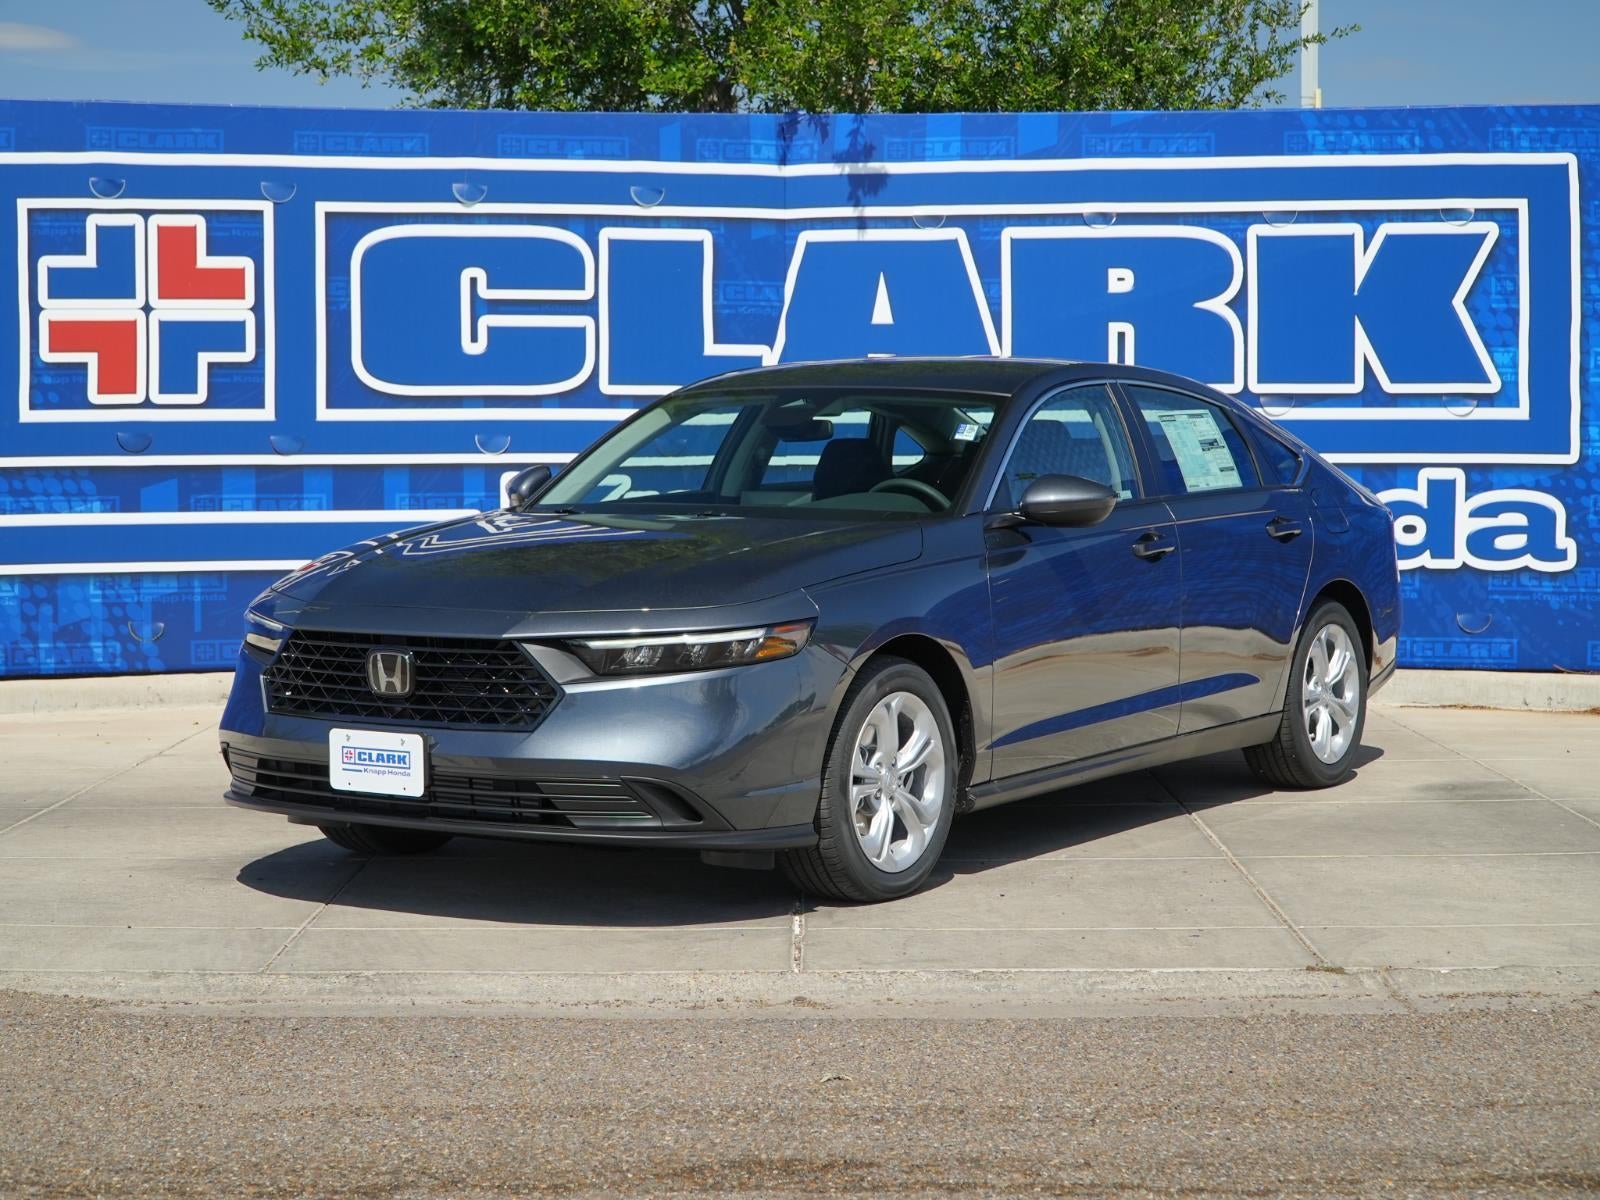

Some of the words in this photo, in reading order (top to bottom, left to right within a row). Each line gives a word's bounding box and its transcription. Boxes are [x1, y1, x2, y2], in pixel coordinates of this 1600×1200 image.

[117, 133, 217, 148] CLARK
[325, 136, 425, 152] CLARK
[527, 139, 623, 155] CLARK
[1111, 138, 1208, 152] CLARK
[350, 223, 1501, 398] CLARK
[1413, 642, 1512, 658] CLARK
[357, 751, 407, 765] CLARK
[363, 768, 387, 776] Knapp
[387, 769, 411, 777] Honda
